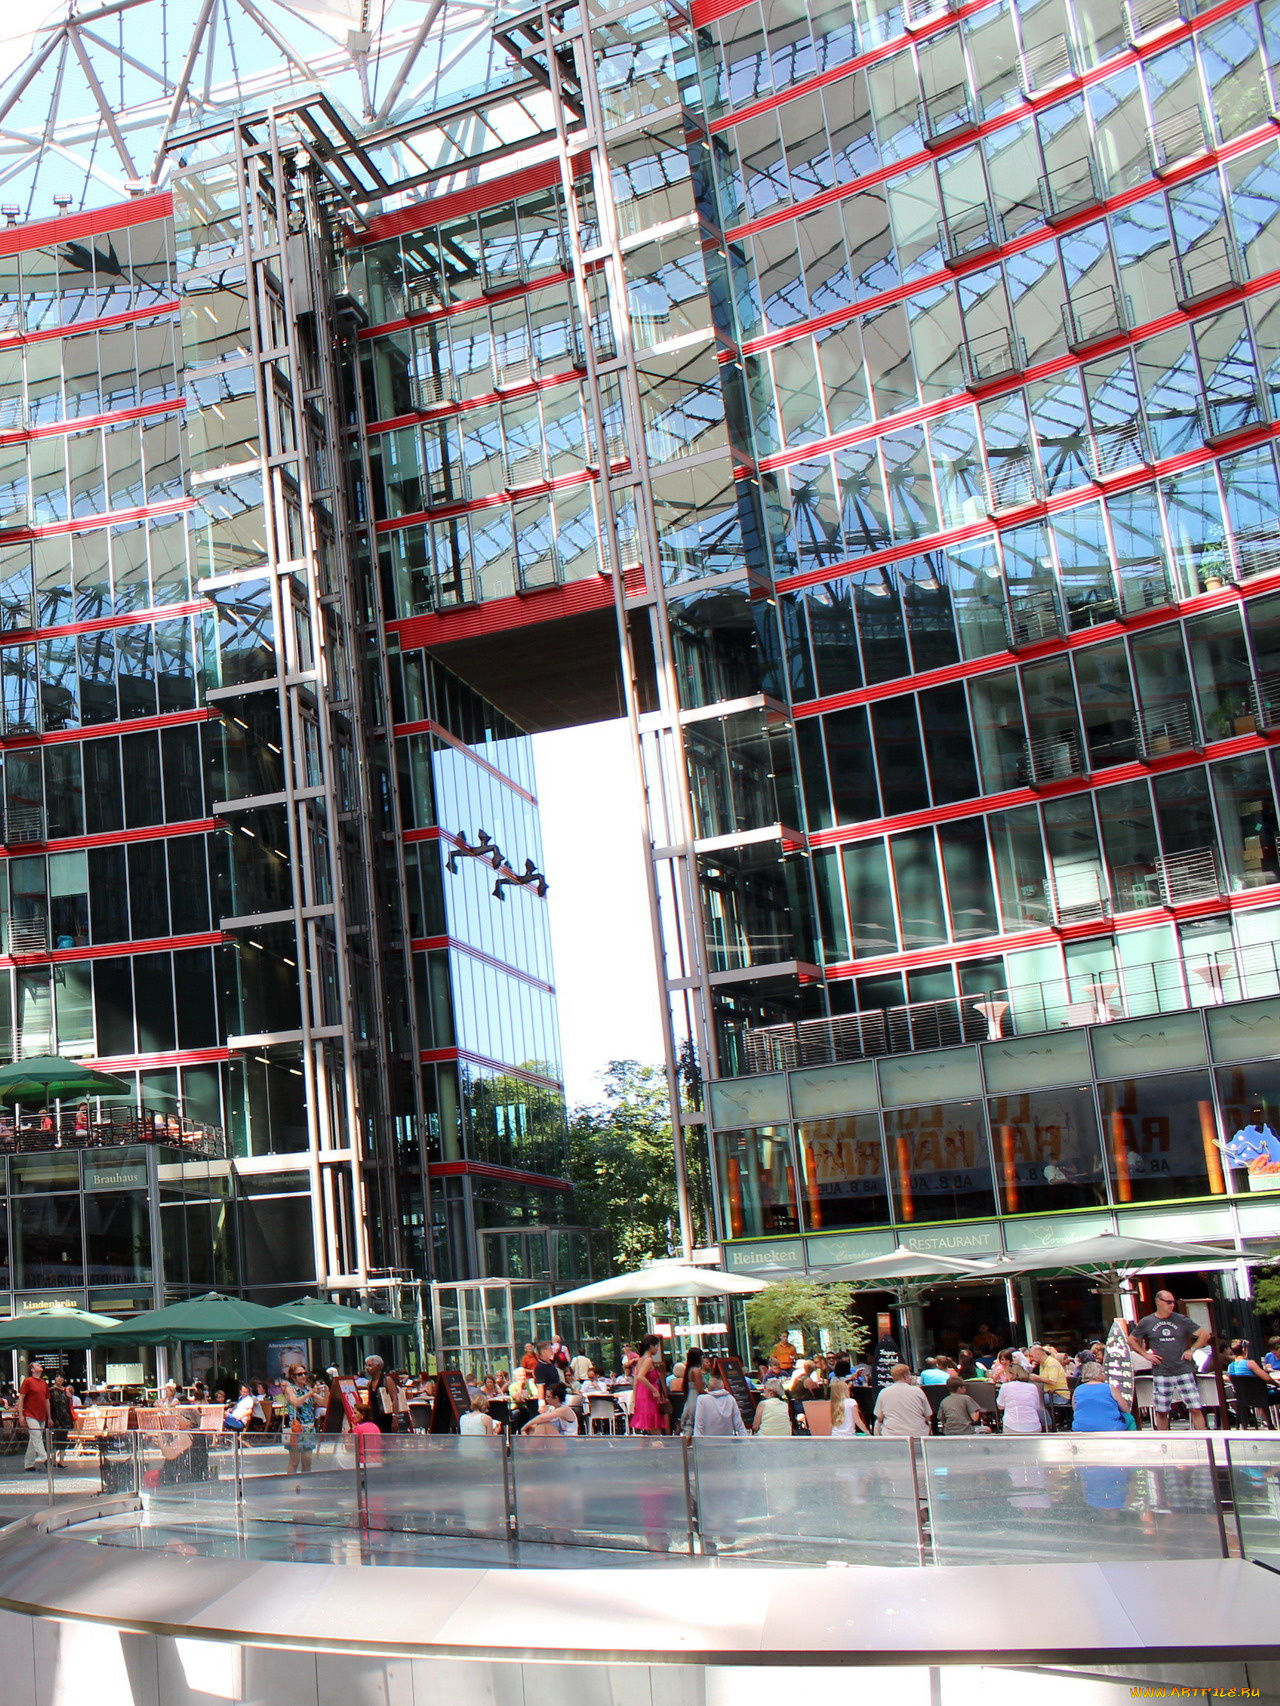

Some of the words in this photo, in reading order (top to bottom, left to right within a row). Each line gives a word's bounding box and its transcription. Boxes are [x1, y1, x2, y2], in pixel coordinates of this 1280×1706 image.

[93, 1173, 138, 1185] Brauhaus
[908, 1234, 991, 1251] RESTAURANT
[733, 1250, 797, 1265] Heineken
